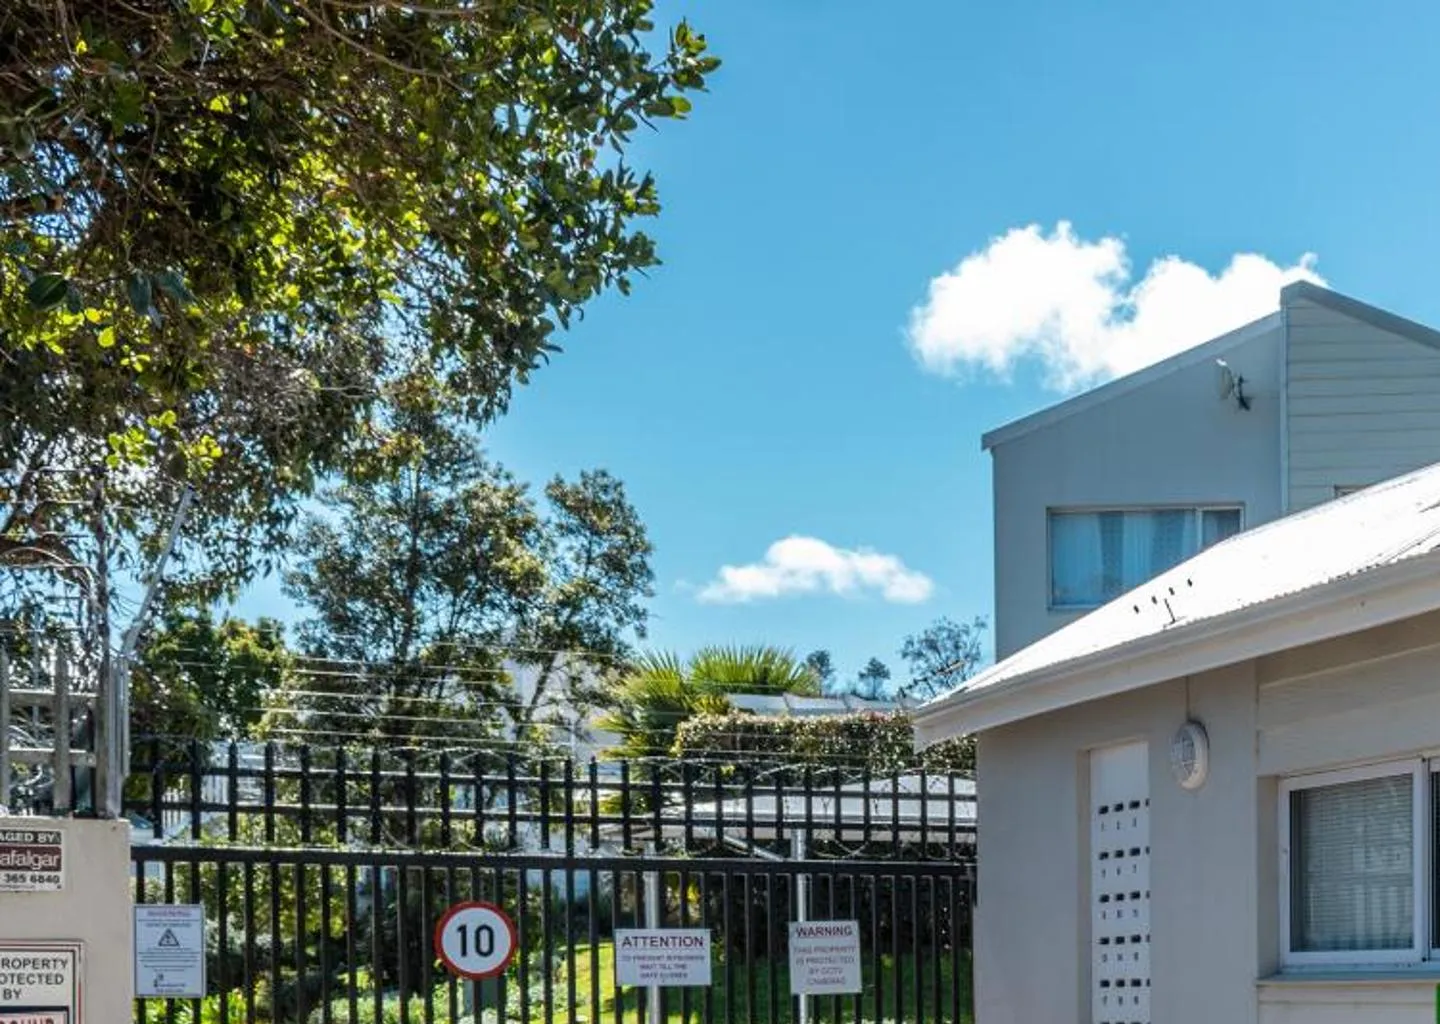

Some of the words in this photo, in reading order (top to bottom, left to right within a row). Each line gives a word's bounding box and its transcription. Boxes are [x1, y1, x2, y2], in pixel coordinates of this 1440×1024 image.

[37, 832, 54, 843] BY
[796, 925, 853, 937] WARNING
[456, 924, 494, 958] 10
[622, 935, 704, 948] ATTENTION
[1, 958, 68, 969] ROPERTY
[0, 973, 64, 985] OTECTED
[3, 988, 22, 1000] BY
